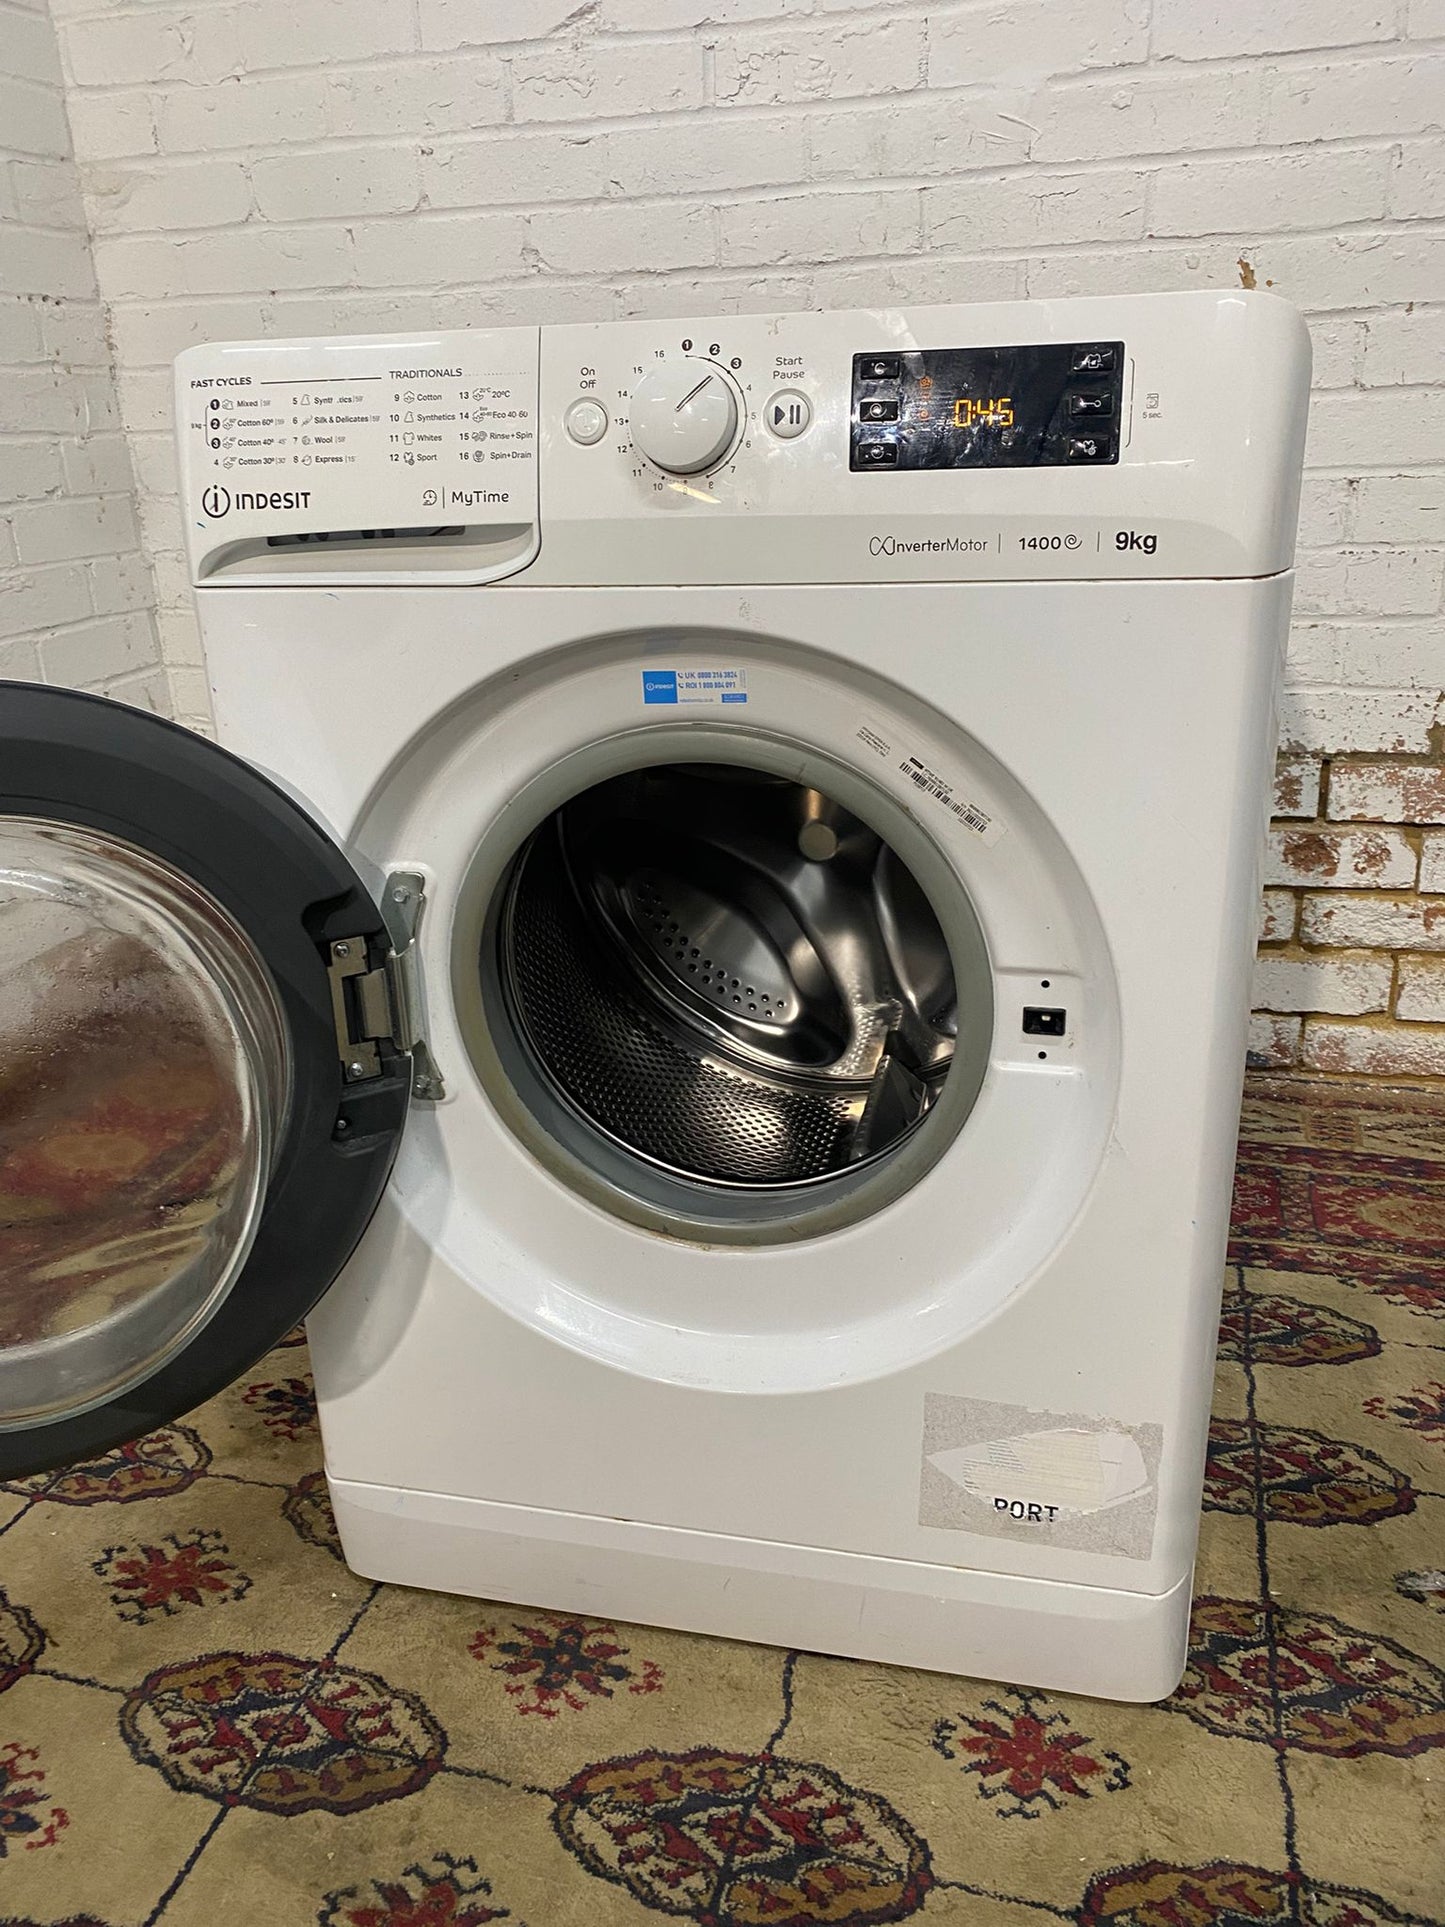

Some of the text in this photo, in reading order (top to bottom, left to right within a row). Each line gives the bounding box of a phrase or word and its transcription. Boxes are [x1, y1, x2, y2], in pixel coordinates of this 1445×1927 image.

[775, 356, 803, 366] Start
[389, 368, 463, 379] TRADITIONALS
[580, 367, 596, 377] On
[633, 366, 643, 374] 15
[772, 369, 805, 380] Pause
[190, 377, 252, 389] FAST CYCLES
[580, 380, 596, 389] Off
[417, 393, 442, 401] Cotton
[459, 392, 469, 400] 13
[237, 400, 258, 408] Mixed
[459, 412, 469, 420] 14
[492, 411, 506, 419] Eco
[954, 398, 1014, 428] 0:45
[314, 416, 328, 424] Silk
[335, 415, 368, 423] Delicates
[389, 413, 456, 423] 10 Synthetics
[237, 419, 260, 427] Cotton
[314, 436, 333, 444] Wool
[389, 434, 442, 442] 11 Whites
[459, 432, 469, 440] 15
[238, 439, 261, 447] Cotton
[617, 446, 627, 454] 12
[315, 456, 343, 464] Express
[389, 453, 437, 462] 12 Sport
[459, 452, 469, 460] 16
[213, 458, 219, 466] 4
[238, 458, 262, 466] Cotton
[632, 469, 642, 477] 11
[653, 483, 663, 491] 10
[451, 490, 509, 506] MyTime
[1018, 536, 1062, 550] 1400
[1115, 531, 1158, 554] 9kg
